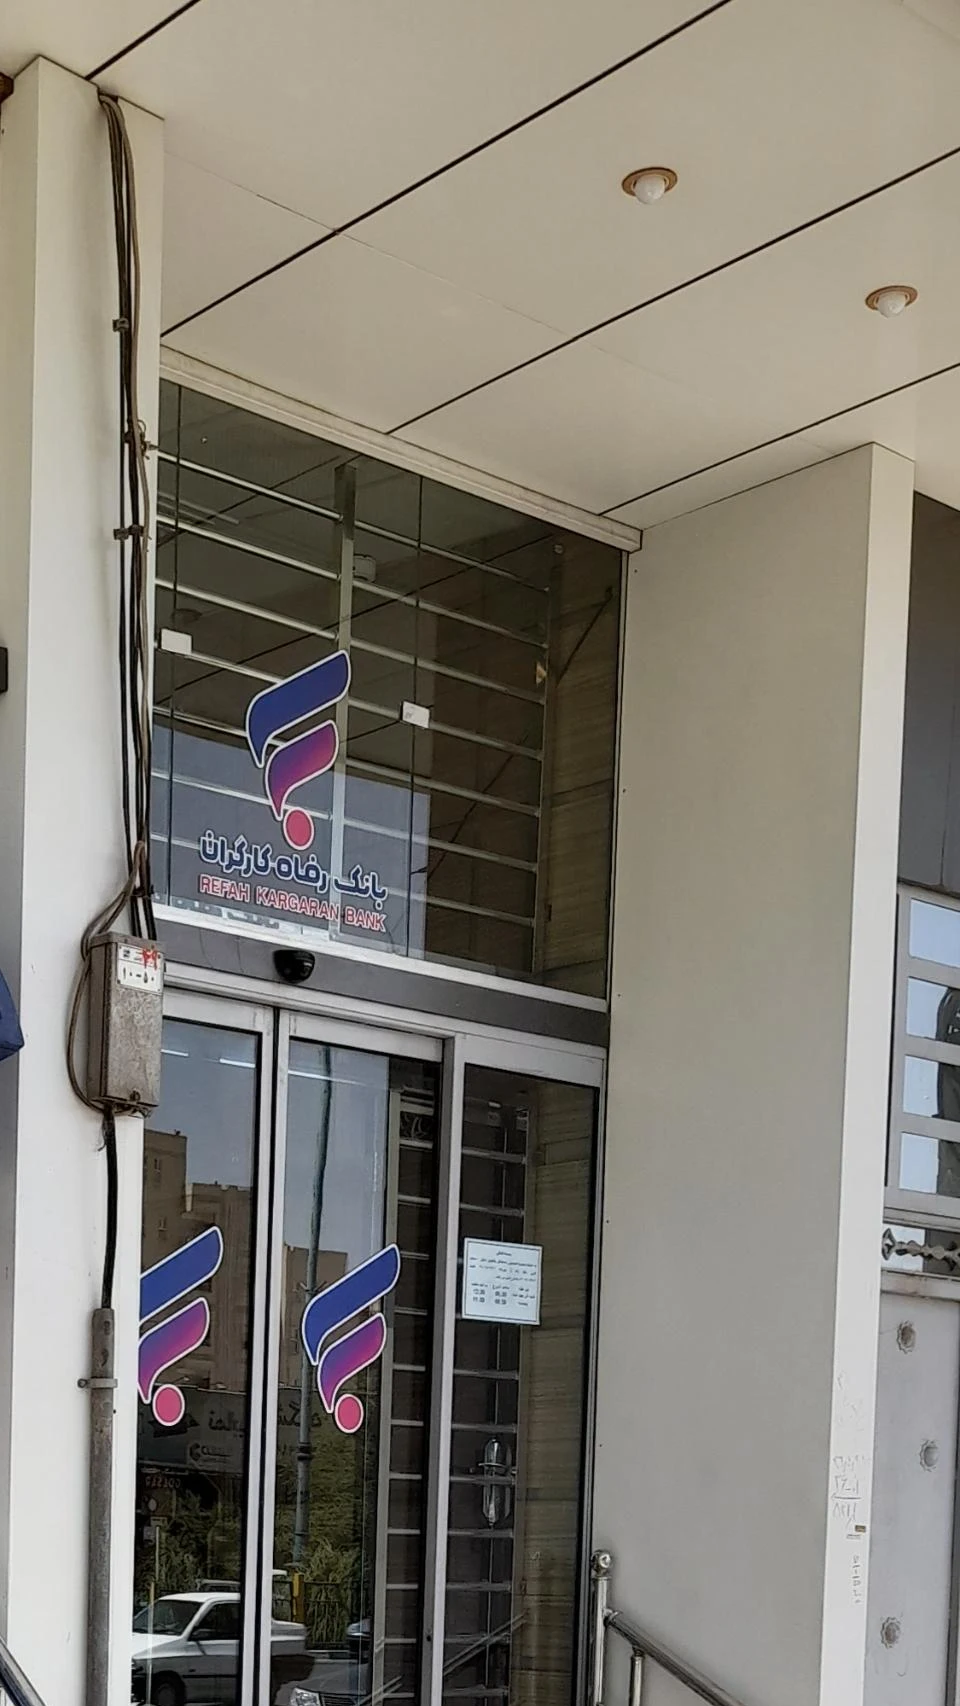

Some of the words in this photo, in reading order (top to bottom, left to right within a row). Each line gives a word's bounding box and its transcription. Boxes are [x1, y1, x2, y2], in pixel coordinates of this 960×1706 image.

[200, 830, 272, 877] کارگران
[276, 854, 328, 893] رفاه
[200, 874, 251, 904] REFAH
[255, 886, 340, 922] KARGARAN
[344, 906, 387, 933] BANK
[334, 866, 387, 910] بانک
